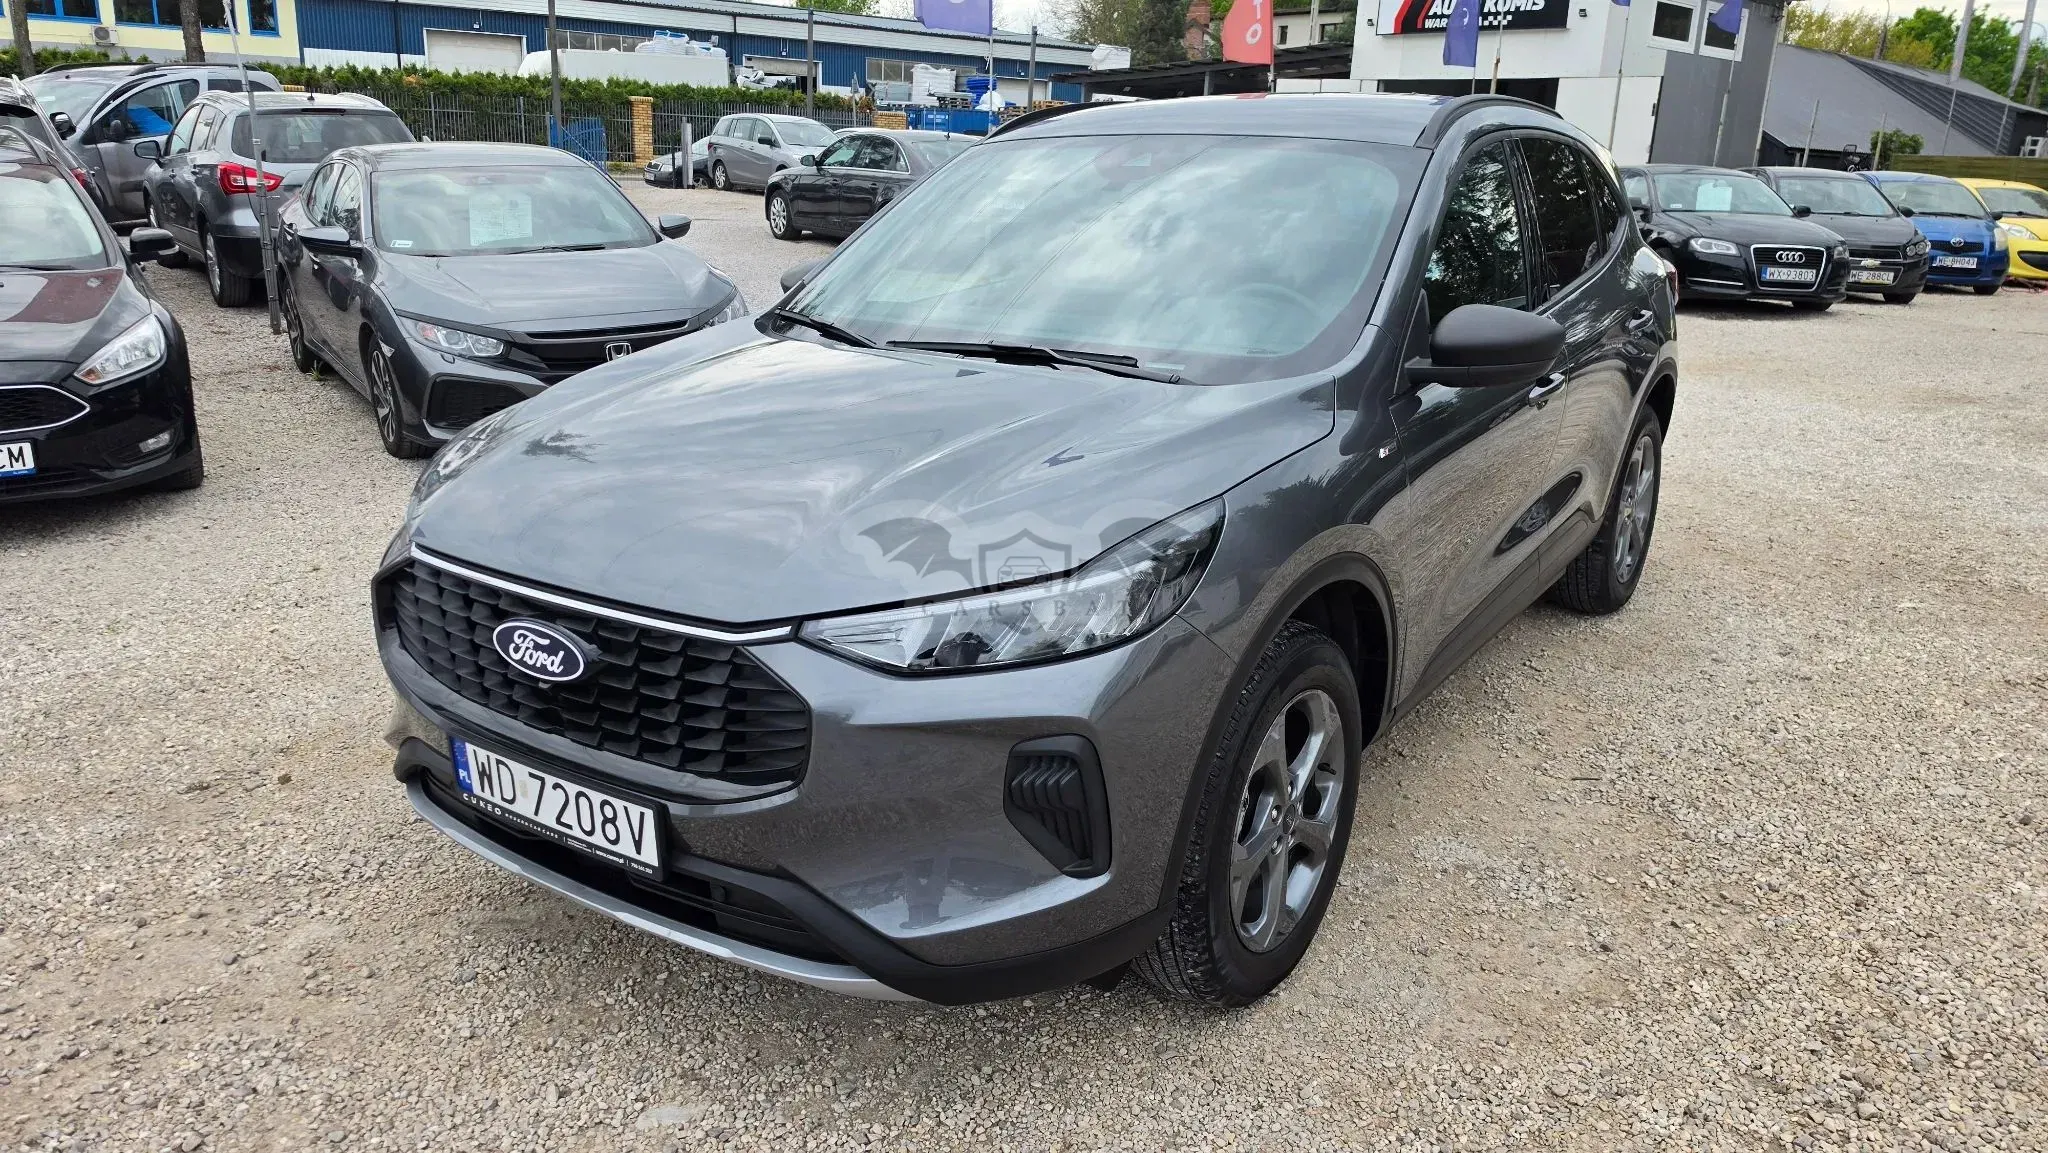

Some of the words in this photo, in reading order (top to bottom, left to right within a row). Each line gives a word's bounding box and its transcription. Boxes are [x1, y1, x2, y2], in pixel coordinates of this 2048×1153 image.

[1769, 269, 1782, 279] WX
[1787, 270, 1815, 280] 93803
[508, 629, 565, 674] Ford
[459, 768, 471, 784] PL
[462, 793, 502, 815] CUKEO
[473, 749, 516, 806] WD
[527, 771, 646, 856] 7208V
